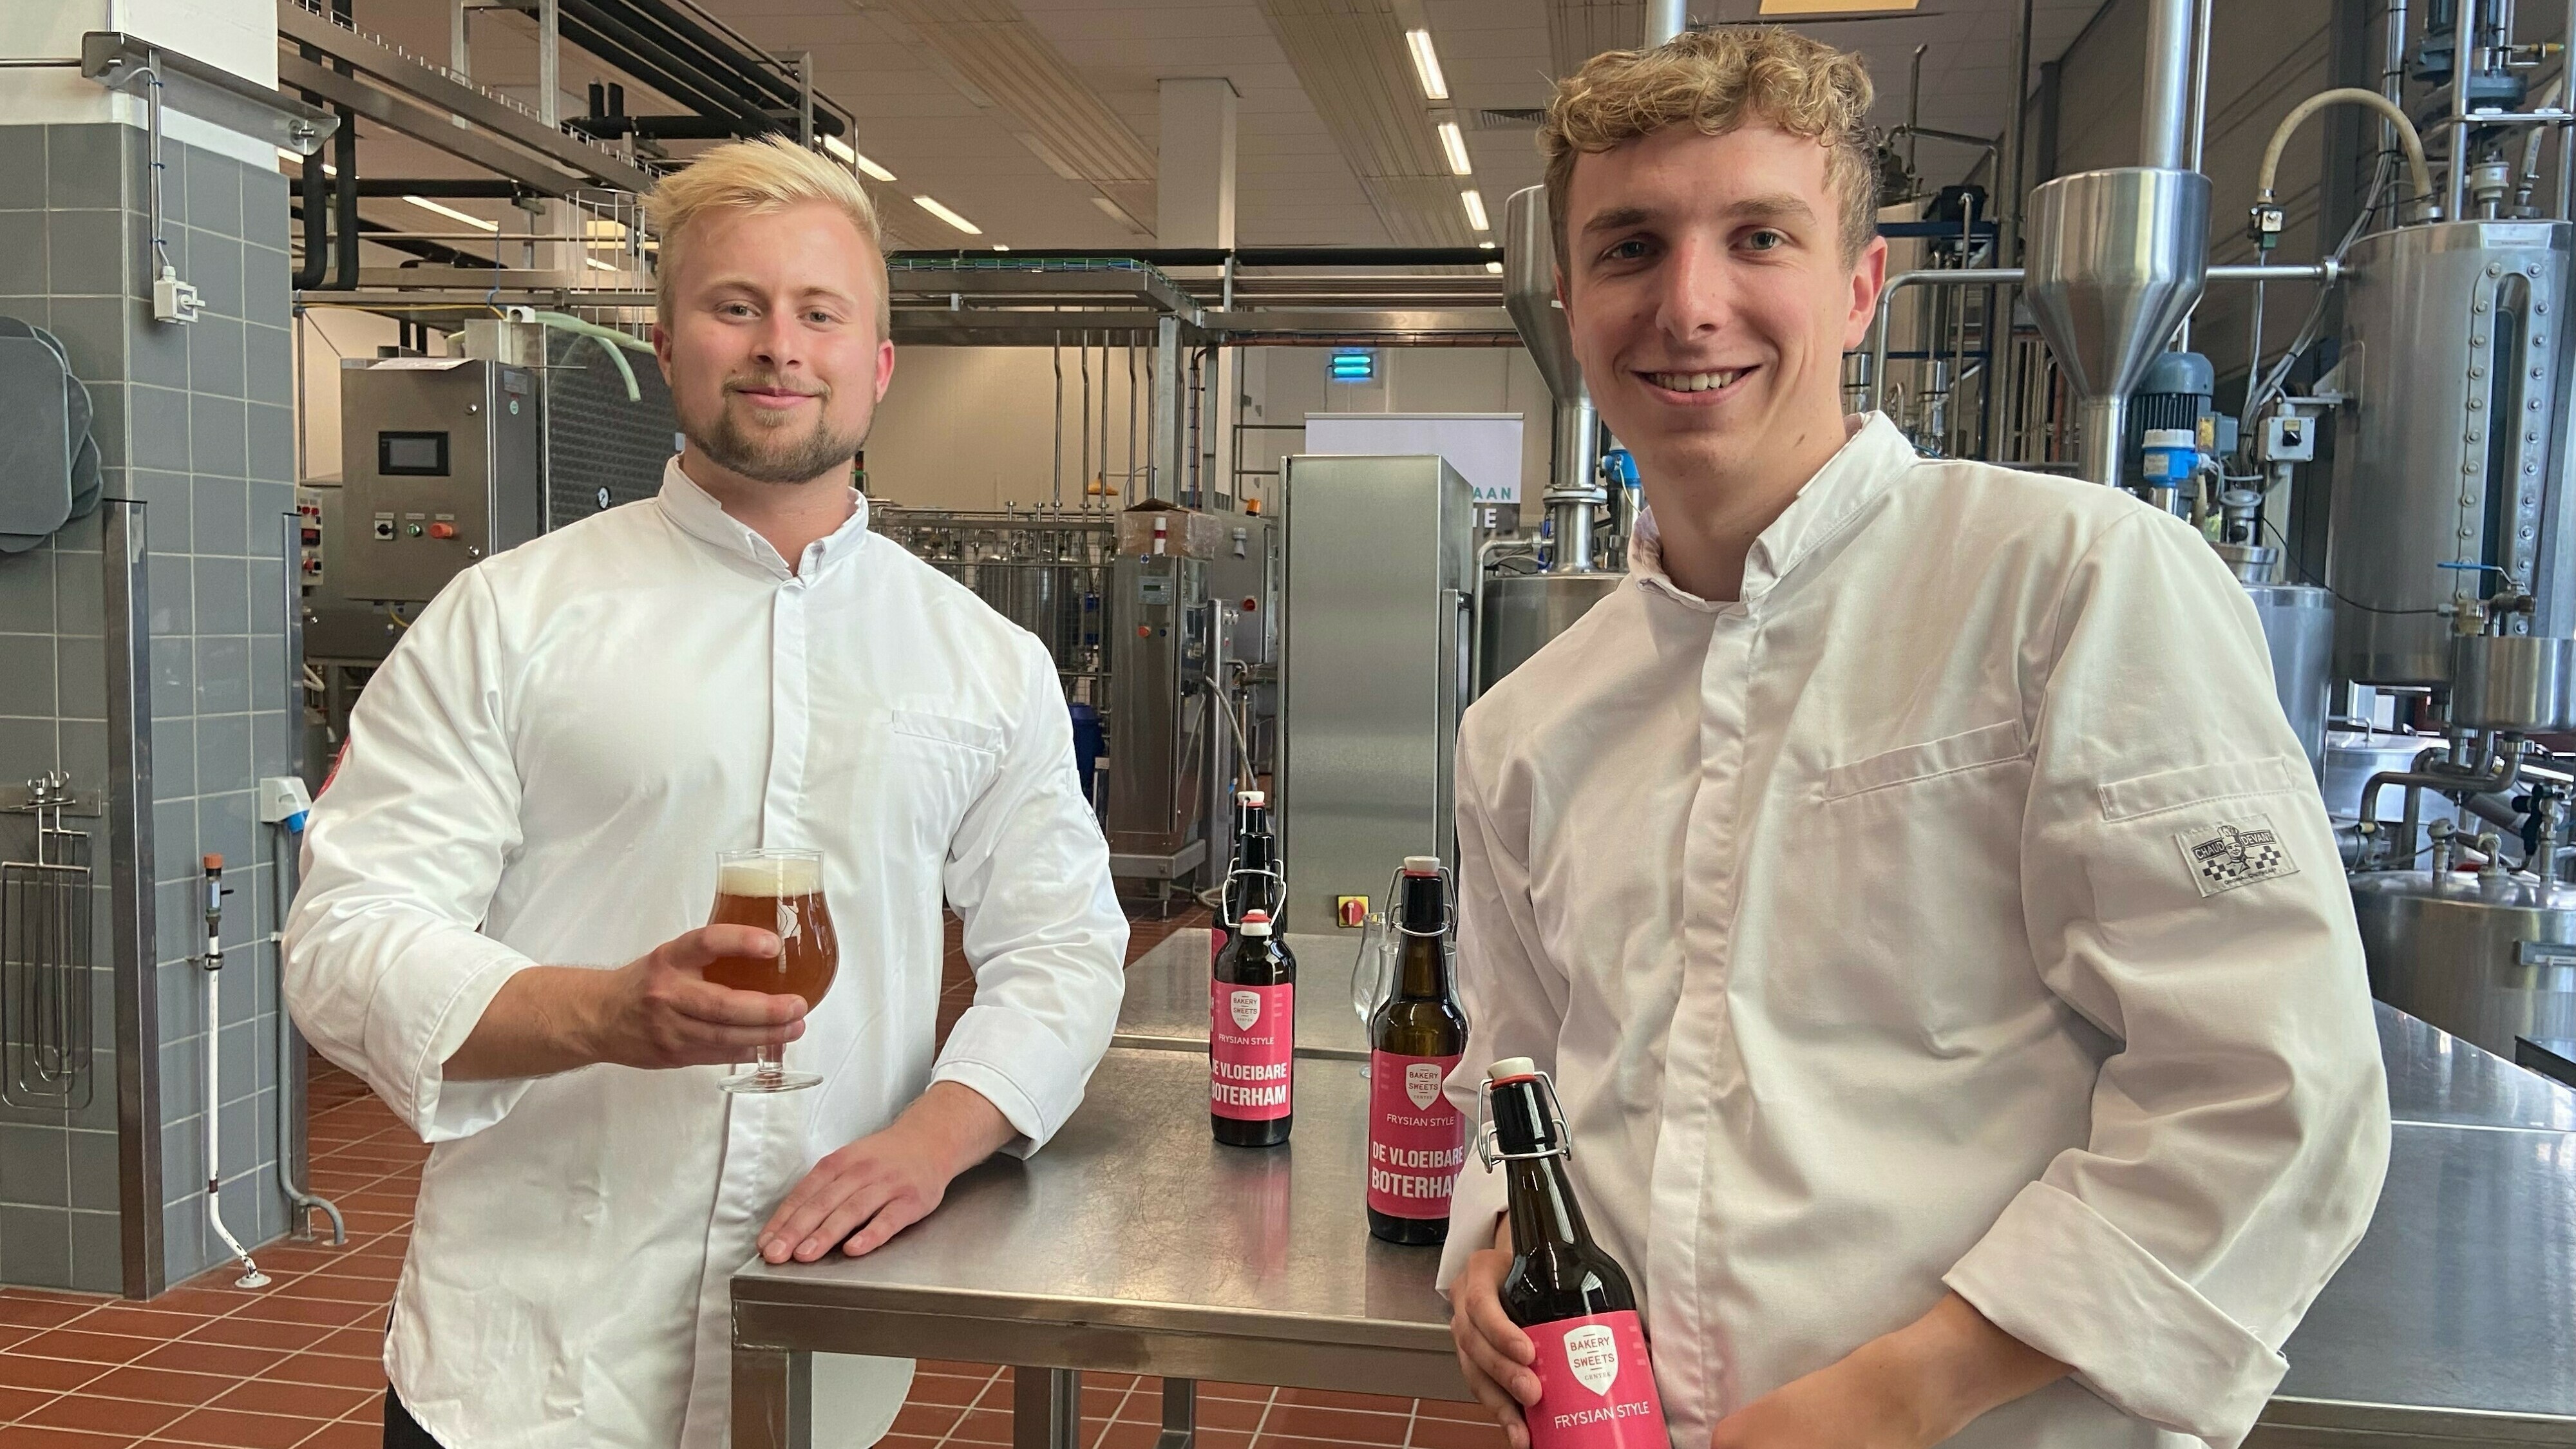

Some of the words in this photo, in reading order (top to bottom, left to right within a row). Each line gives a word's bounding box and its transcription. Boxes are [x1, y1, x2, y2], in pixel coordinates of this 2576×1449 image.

[2195, 841, 2224, 859] CHAUD
[2241, 832, 2273, 846] DEVANT
[1218, 1034, 1249, 1045] FRYSIAN
[1251, 1037, 1274, 1045] STYLE
[1220, 1062, 1287, 1081] VLOEIBARE
[1387, 1113, 1428, 1126] FRYSIAN
[1430, 1117, 1455, 1126] STYLE
[1372, 1141, 1386, 1163] DE
[1389, 1145, 1464, 1168] VLOEIBARE
[1372, 1166, 1459, 1198] BOTERHA
[1570, 1336, 1610, 1351] BAKERY
[1573, 1353, 1615, 1368] SWEETS
[1584, 1372, 1612, 1381] CENTER
[1554, 1406, 1615, 1429] FRYSIAN
[1616, 1401, 1651, 1418] STYLE
